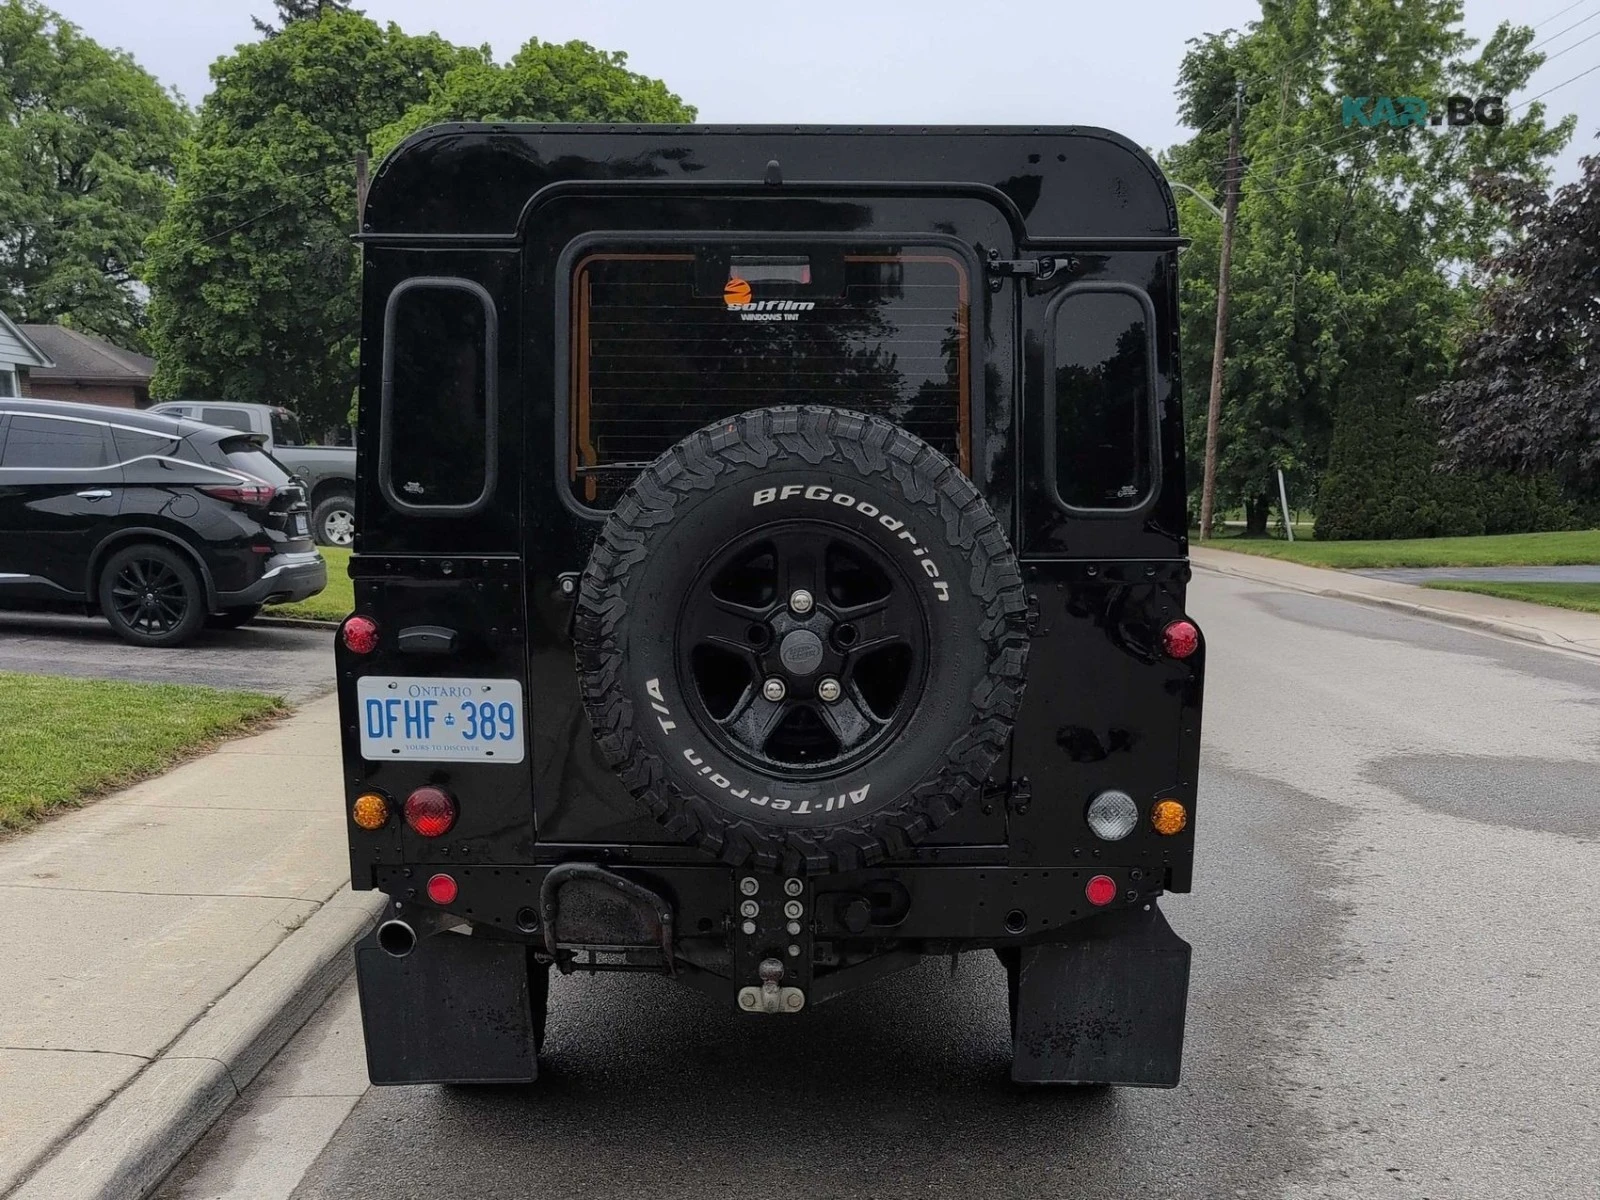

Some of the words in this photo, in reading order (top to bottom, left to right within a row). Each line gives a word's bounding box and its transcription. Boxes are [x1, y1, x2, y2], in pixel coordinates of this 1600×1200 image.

[741, 313, 782, 321] WINDOWS
[783, 313, 800, 321] TINT
[752, 484, 950, 602] BFGoodrich
[366, 699, 437, 739] DFHF
[461, 701, 515, 741] 389
[645, 677, 677, 736] T/A
[683, 748, 871, 815] All-Terrain
